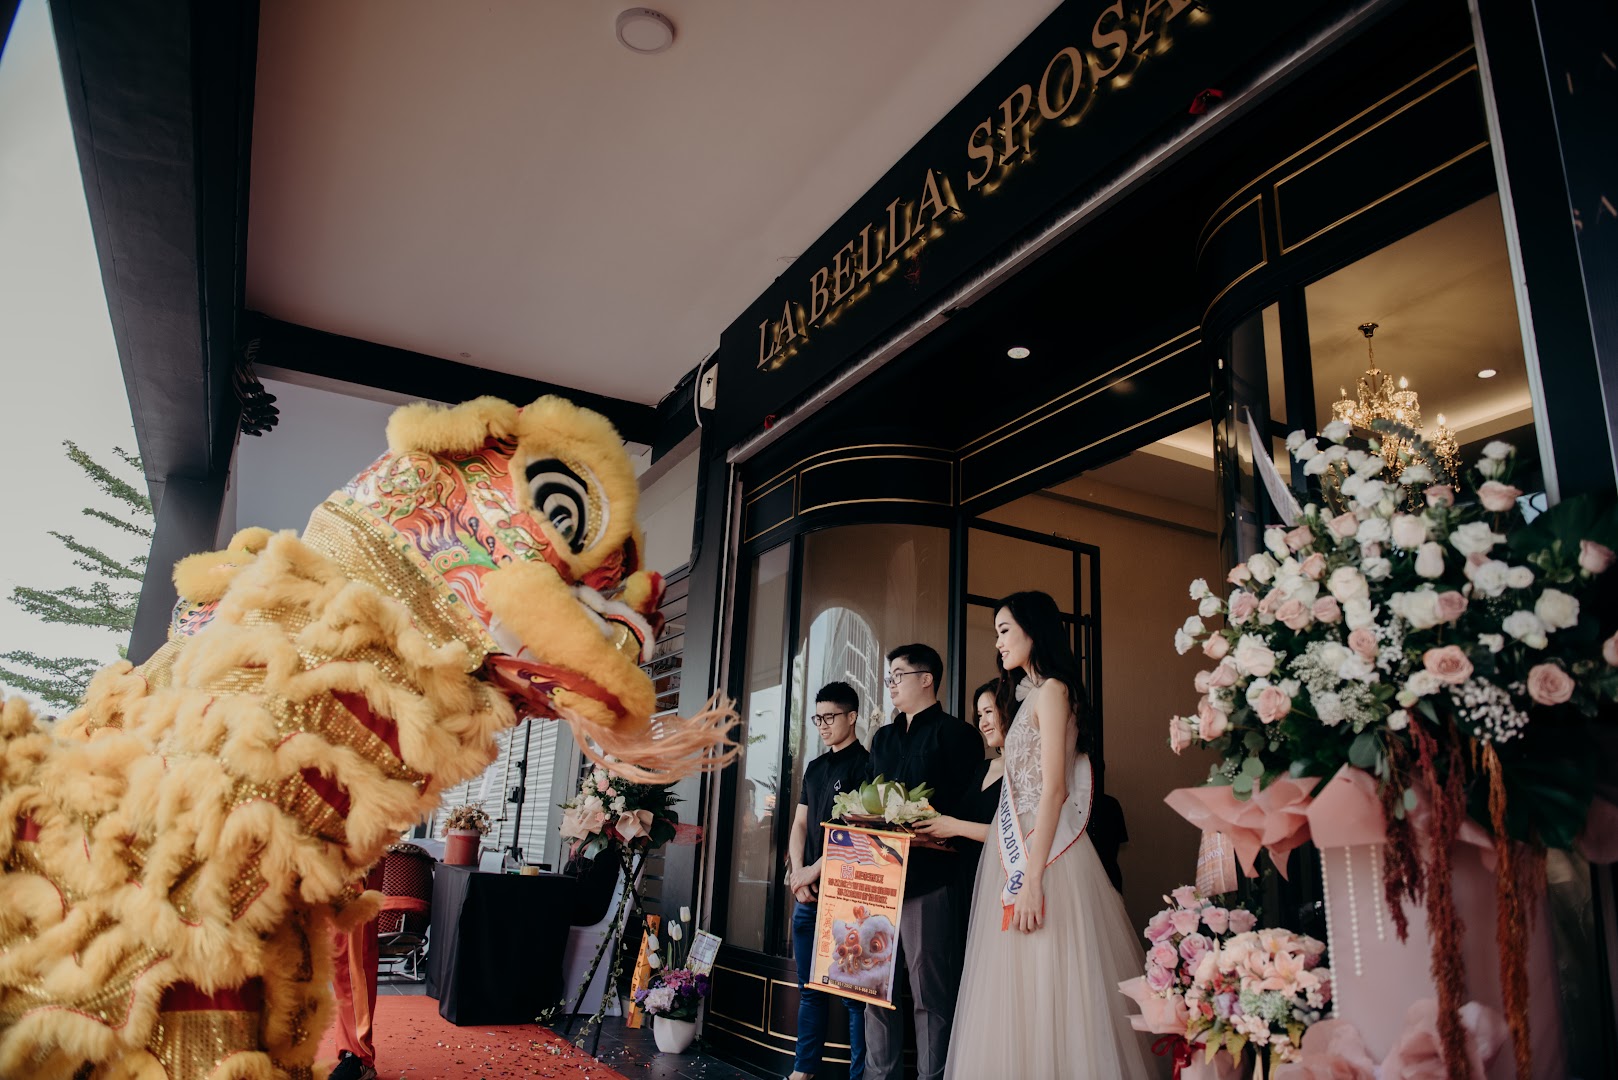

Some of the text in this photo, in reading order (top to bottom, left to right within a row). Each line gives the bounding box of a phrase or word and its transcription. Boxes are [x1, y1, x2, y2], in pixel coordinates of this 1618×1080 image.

[757, 300, 797, 369] LA
[808, 168, 947, 326] BELLA
[1003, 831, 1020, 864] 2018
